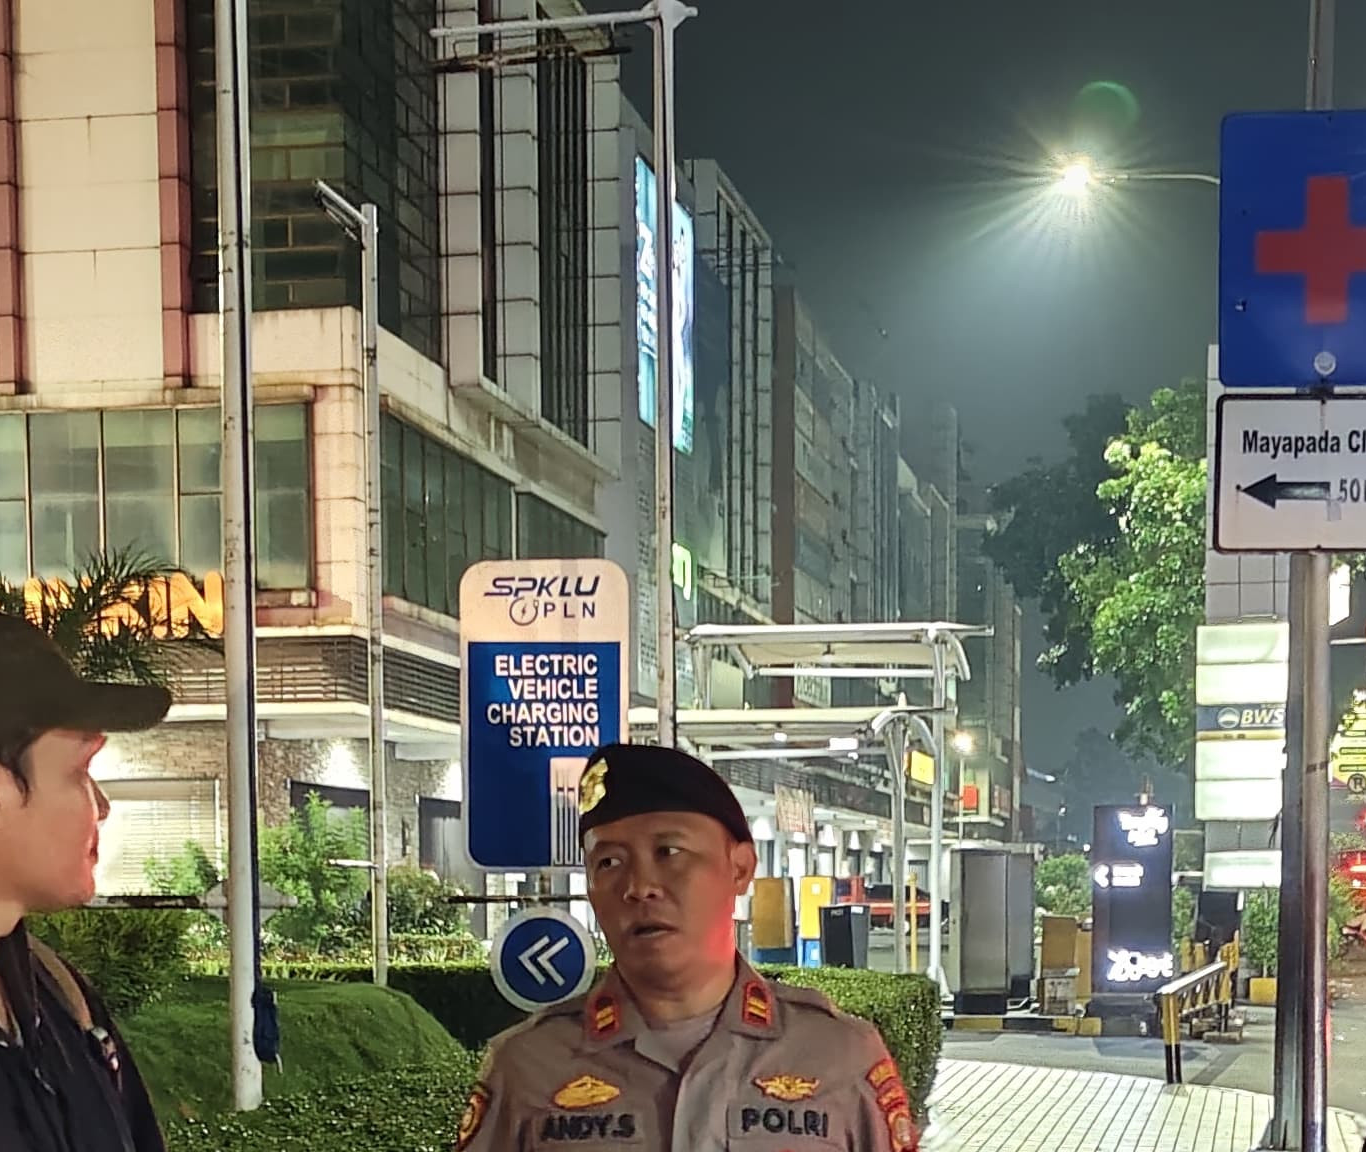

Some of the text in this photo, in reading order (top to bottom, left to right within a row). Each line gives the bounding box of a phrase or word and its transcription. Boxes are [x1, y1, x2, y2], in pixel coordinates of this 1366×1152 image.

[1242, 429, 1341, 459] Mayapada
[484, 575, 601, 598] SPKLU
[543, 602, 595, 619] PLN
[494, 654, 598, 677] ELECTRIC
[508, 678, 599, 700] VEHICLE
[487, 702, 600, 725] CHARGING
[1240, 708, 1285, 724] BWS
[509, 725, 600, 747] STATION
[741, 1107, 829, 1138] POLRI
